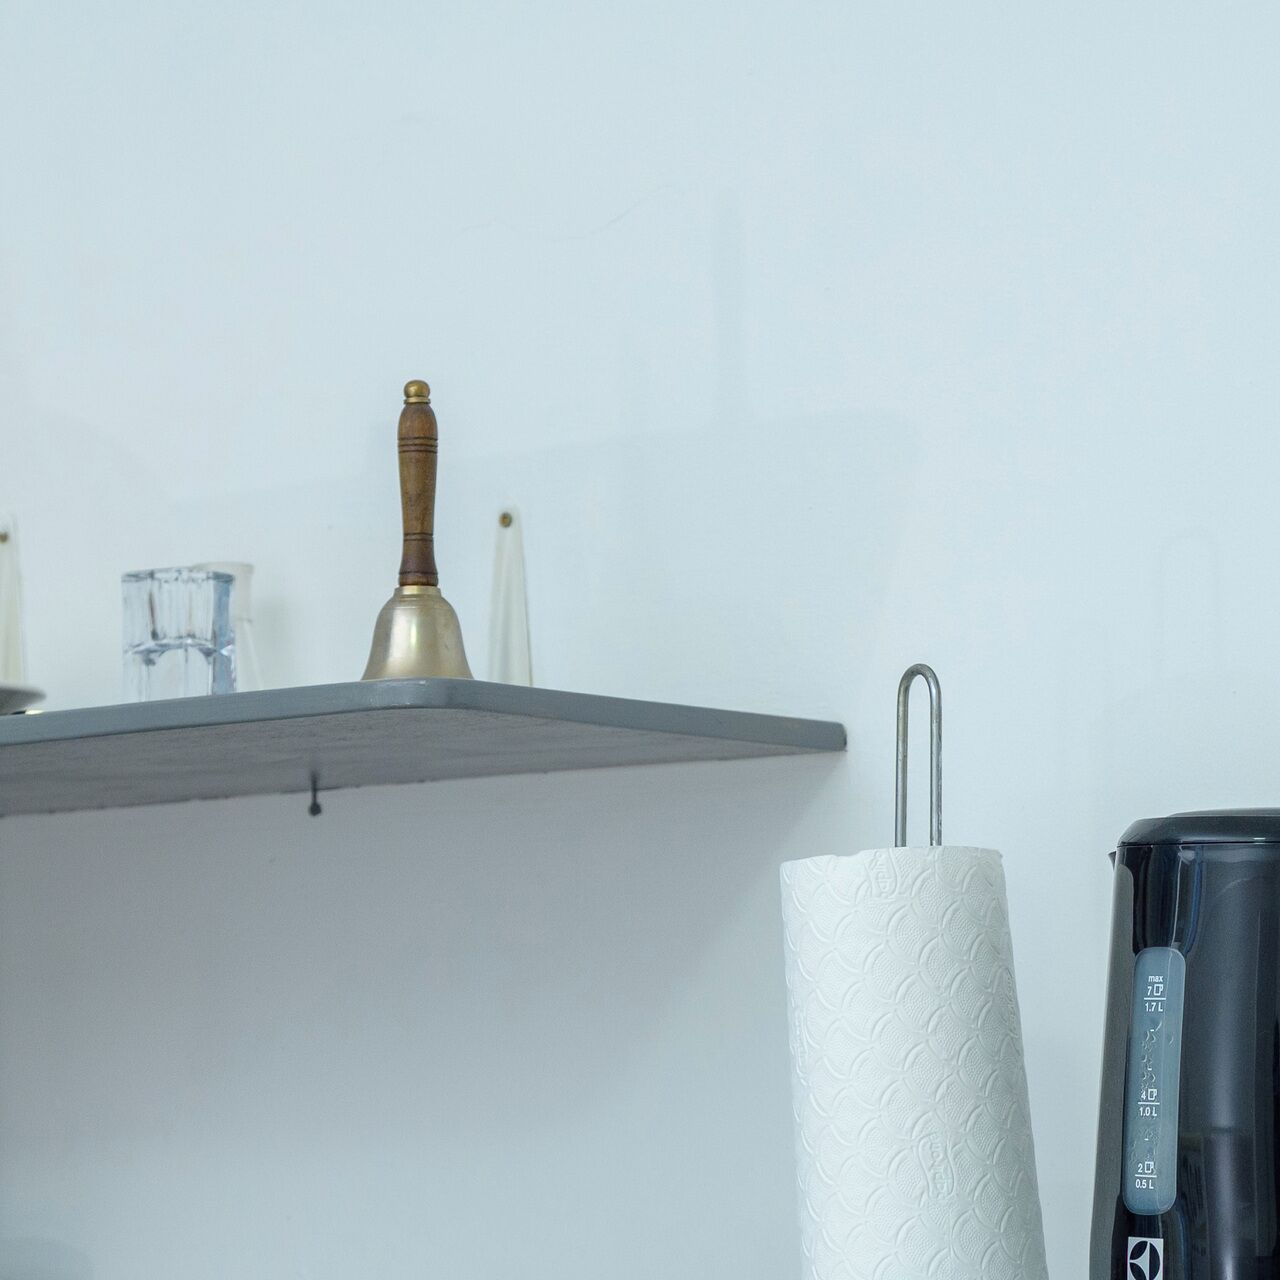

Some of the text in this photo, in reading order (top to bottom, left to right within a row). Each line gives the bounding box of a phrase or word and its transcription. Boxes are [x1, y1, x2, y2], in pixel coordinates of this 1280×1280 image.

[1148, 975, 1164, 983] max
[1147, 985, 1153, 996] 7
[1145, 1002, 1164, 1012] 1.7 L
[1140, 1091, 1146, 1100] 4
[1139, 1107, 1158, 1117] 1.0 L
[1137, 1163, 1143, 1173] 2
[1135, 1179, 1154, 1189] 0.5 L
